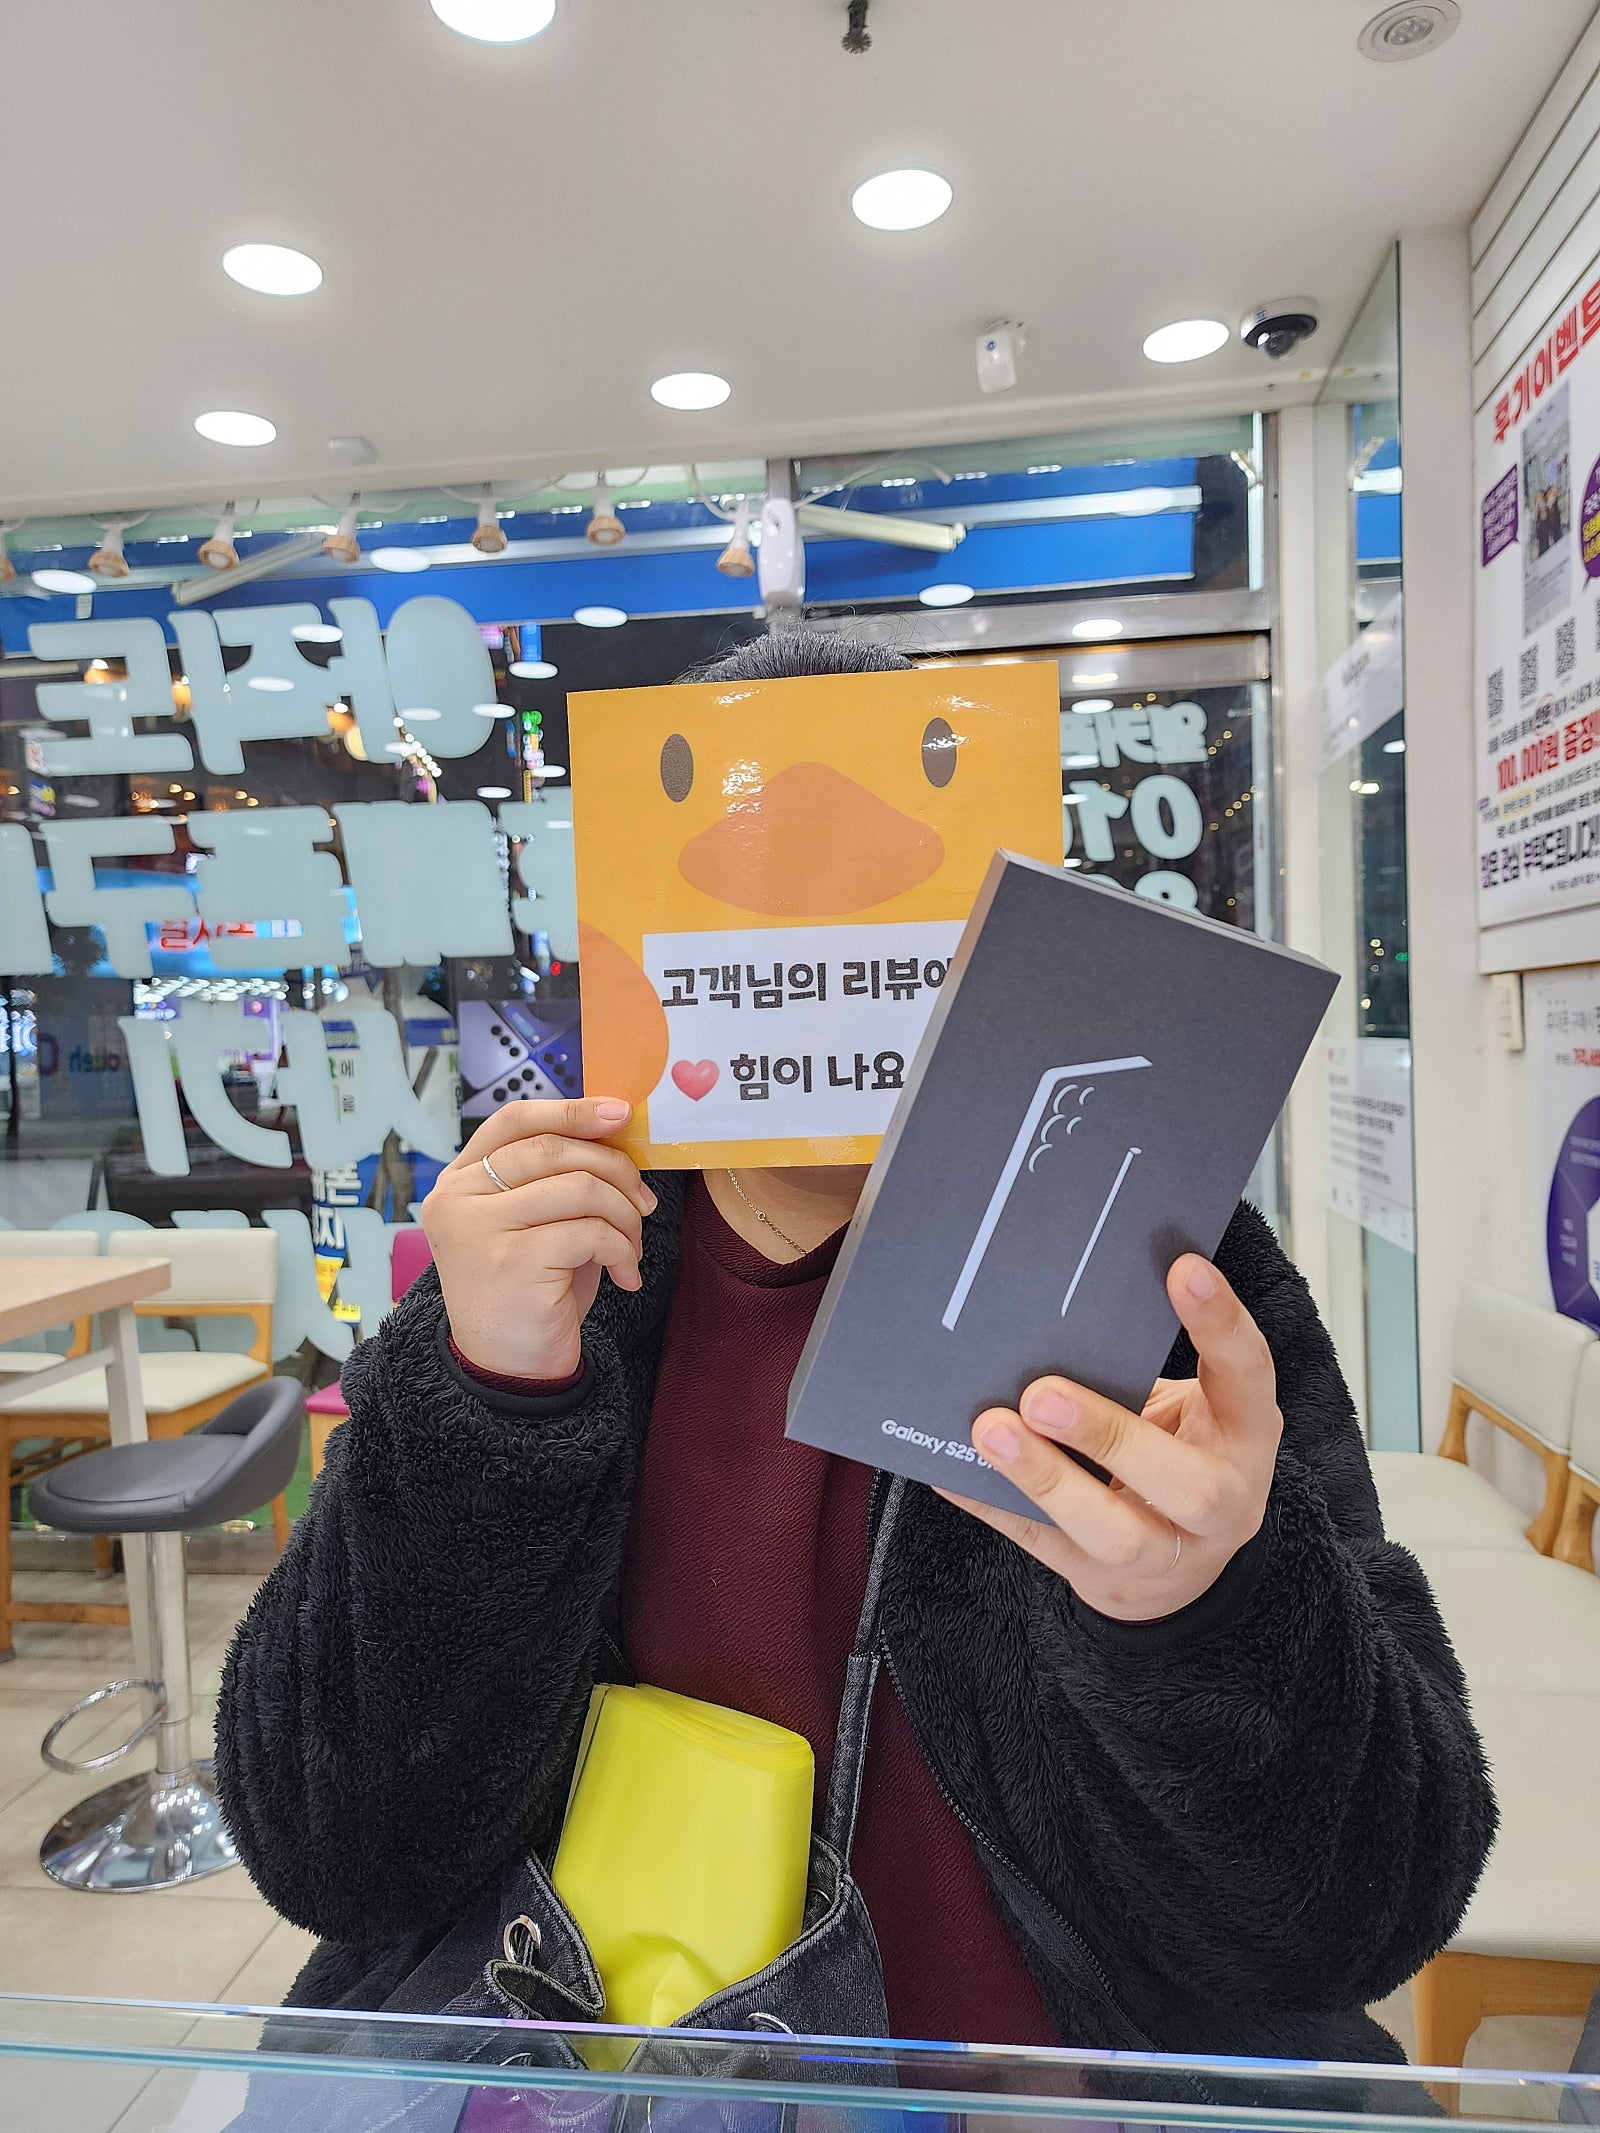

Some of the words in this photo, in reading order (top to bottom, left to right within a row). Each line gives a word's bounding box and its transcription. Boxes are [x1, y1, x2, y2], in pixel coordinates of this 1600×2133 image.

[662, 963, 827, 1009] 고객님의
[730, 1053, 812, 1100] 힘이
[827, 1050, 906, 1091] 나요
[881, 1419, 947, 1454] Galaxy
[944, 1441, 977, 1463] S25
